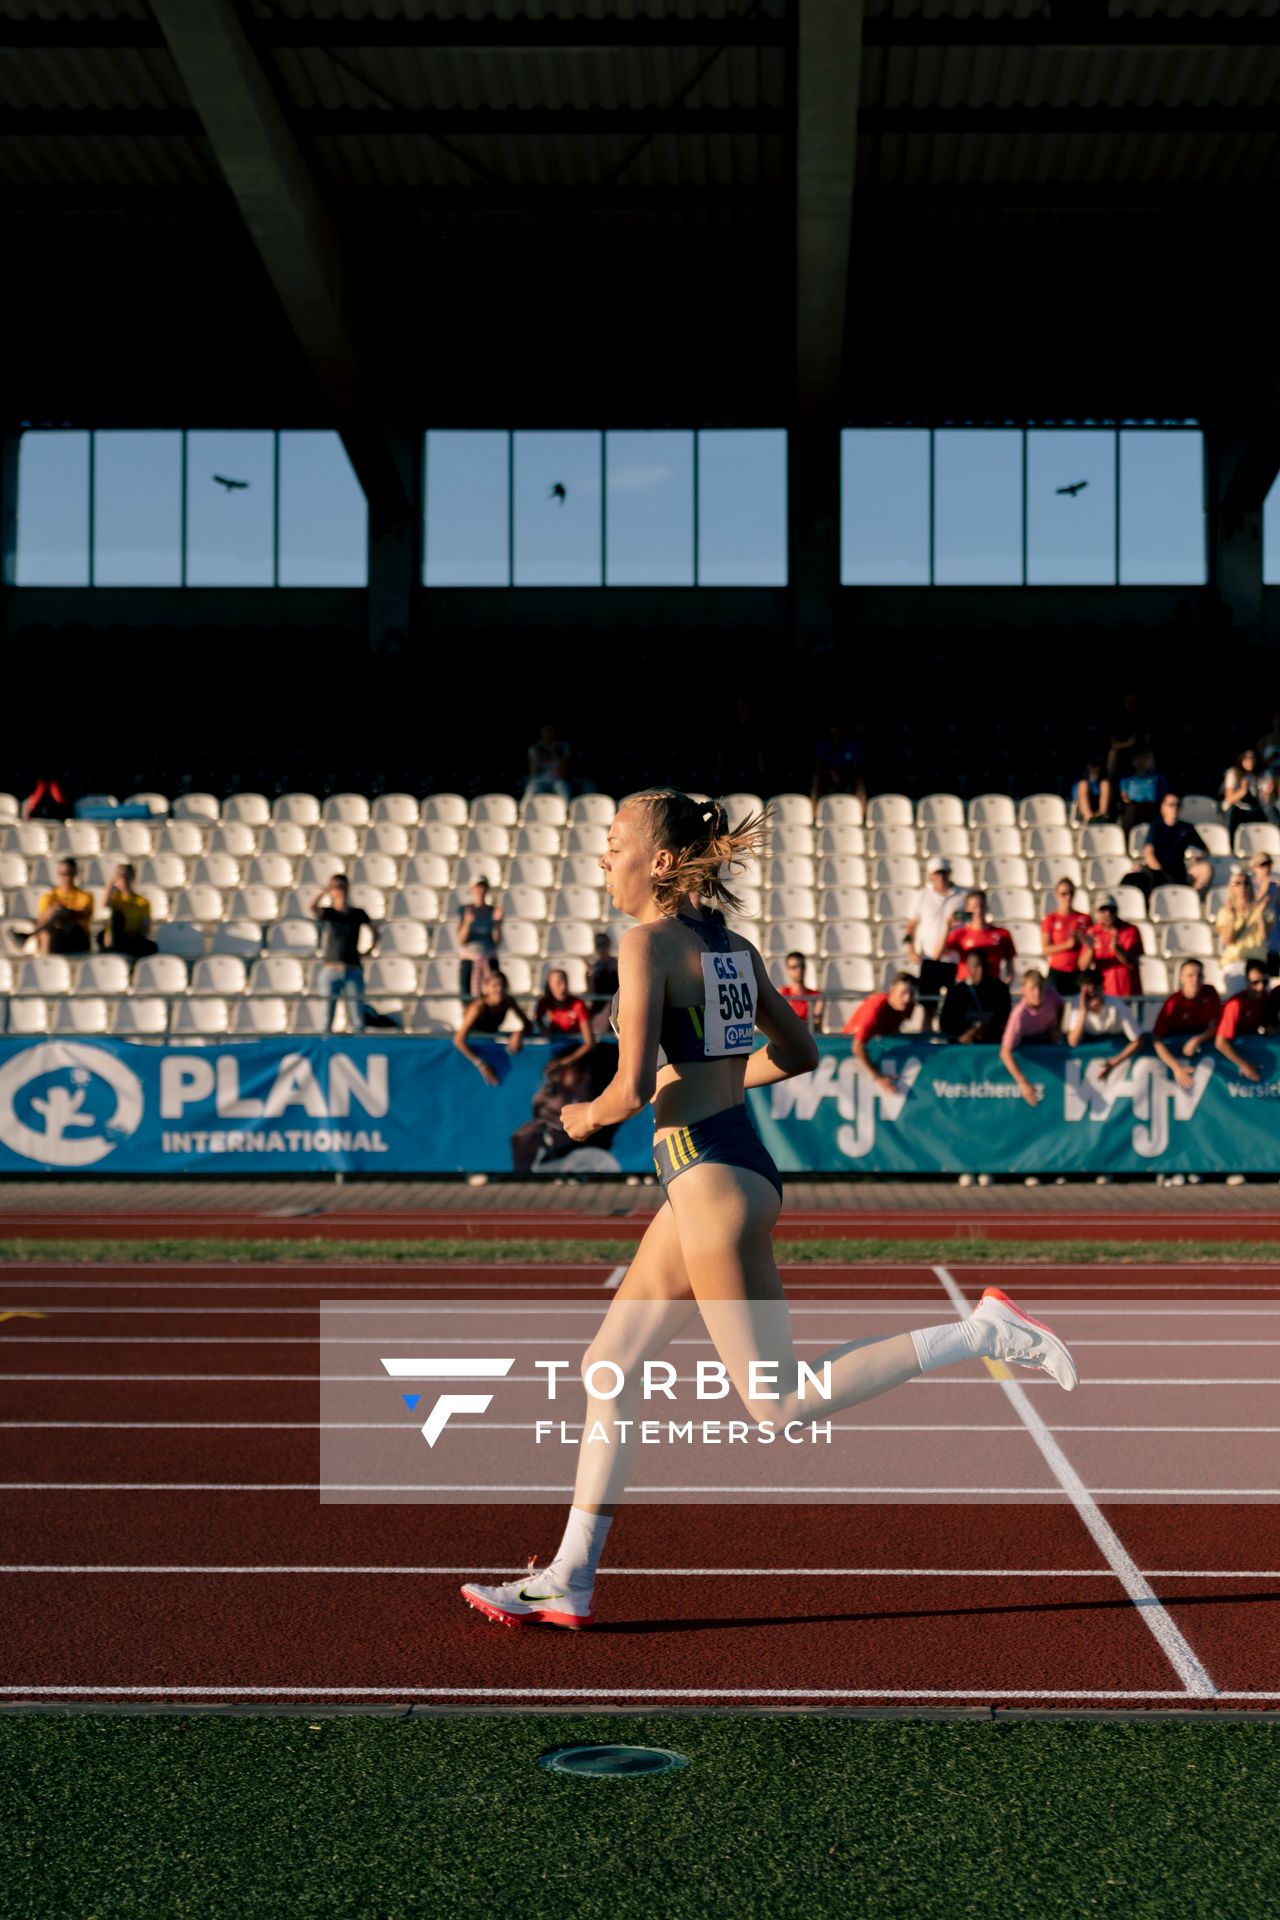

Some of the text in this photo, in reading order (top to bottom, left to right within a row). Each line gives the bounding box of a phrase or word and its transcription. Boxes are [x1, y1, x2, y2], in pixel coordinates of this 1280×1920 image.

[717, 982, 753, 1021] 584
[160, 1053, 389, 1119] PLAN
[932, 1080, 1045, 1101] Versicherug
[1227, 1080, 1280, 1098] Versic
[162, 1131, 389, 1153] INTERNATIONAL
